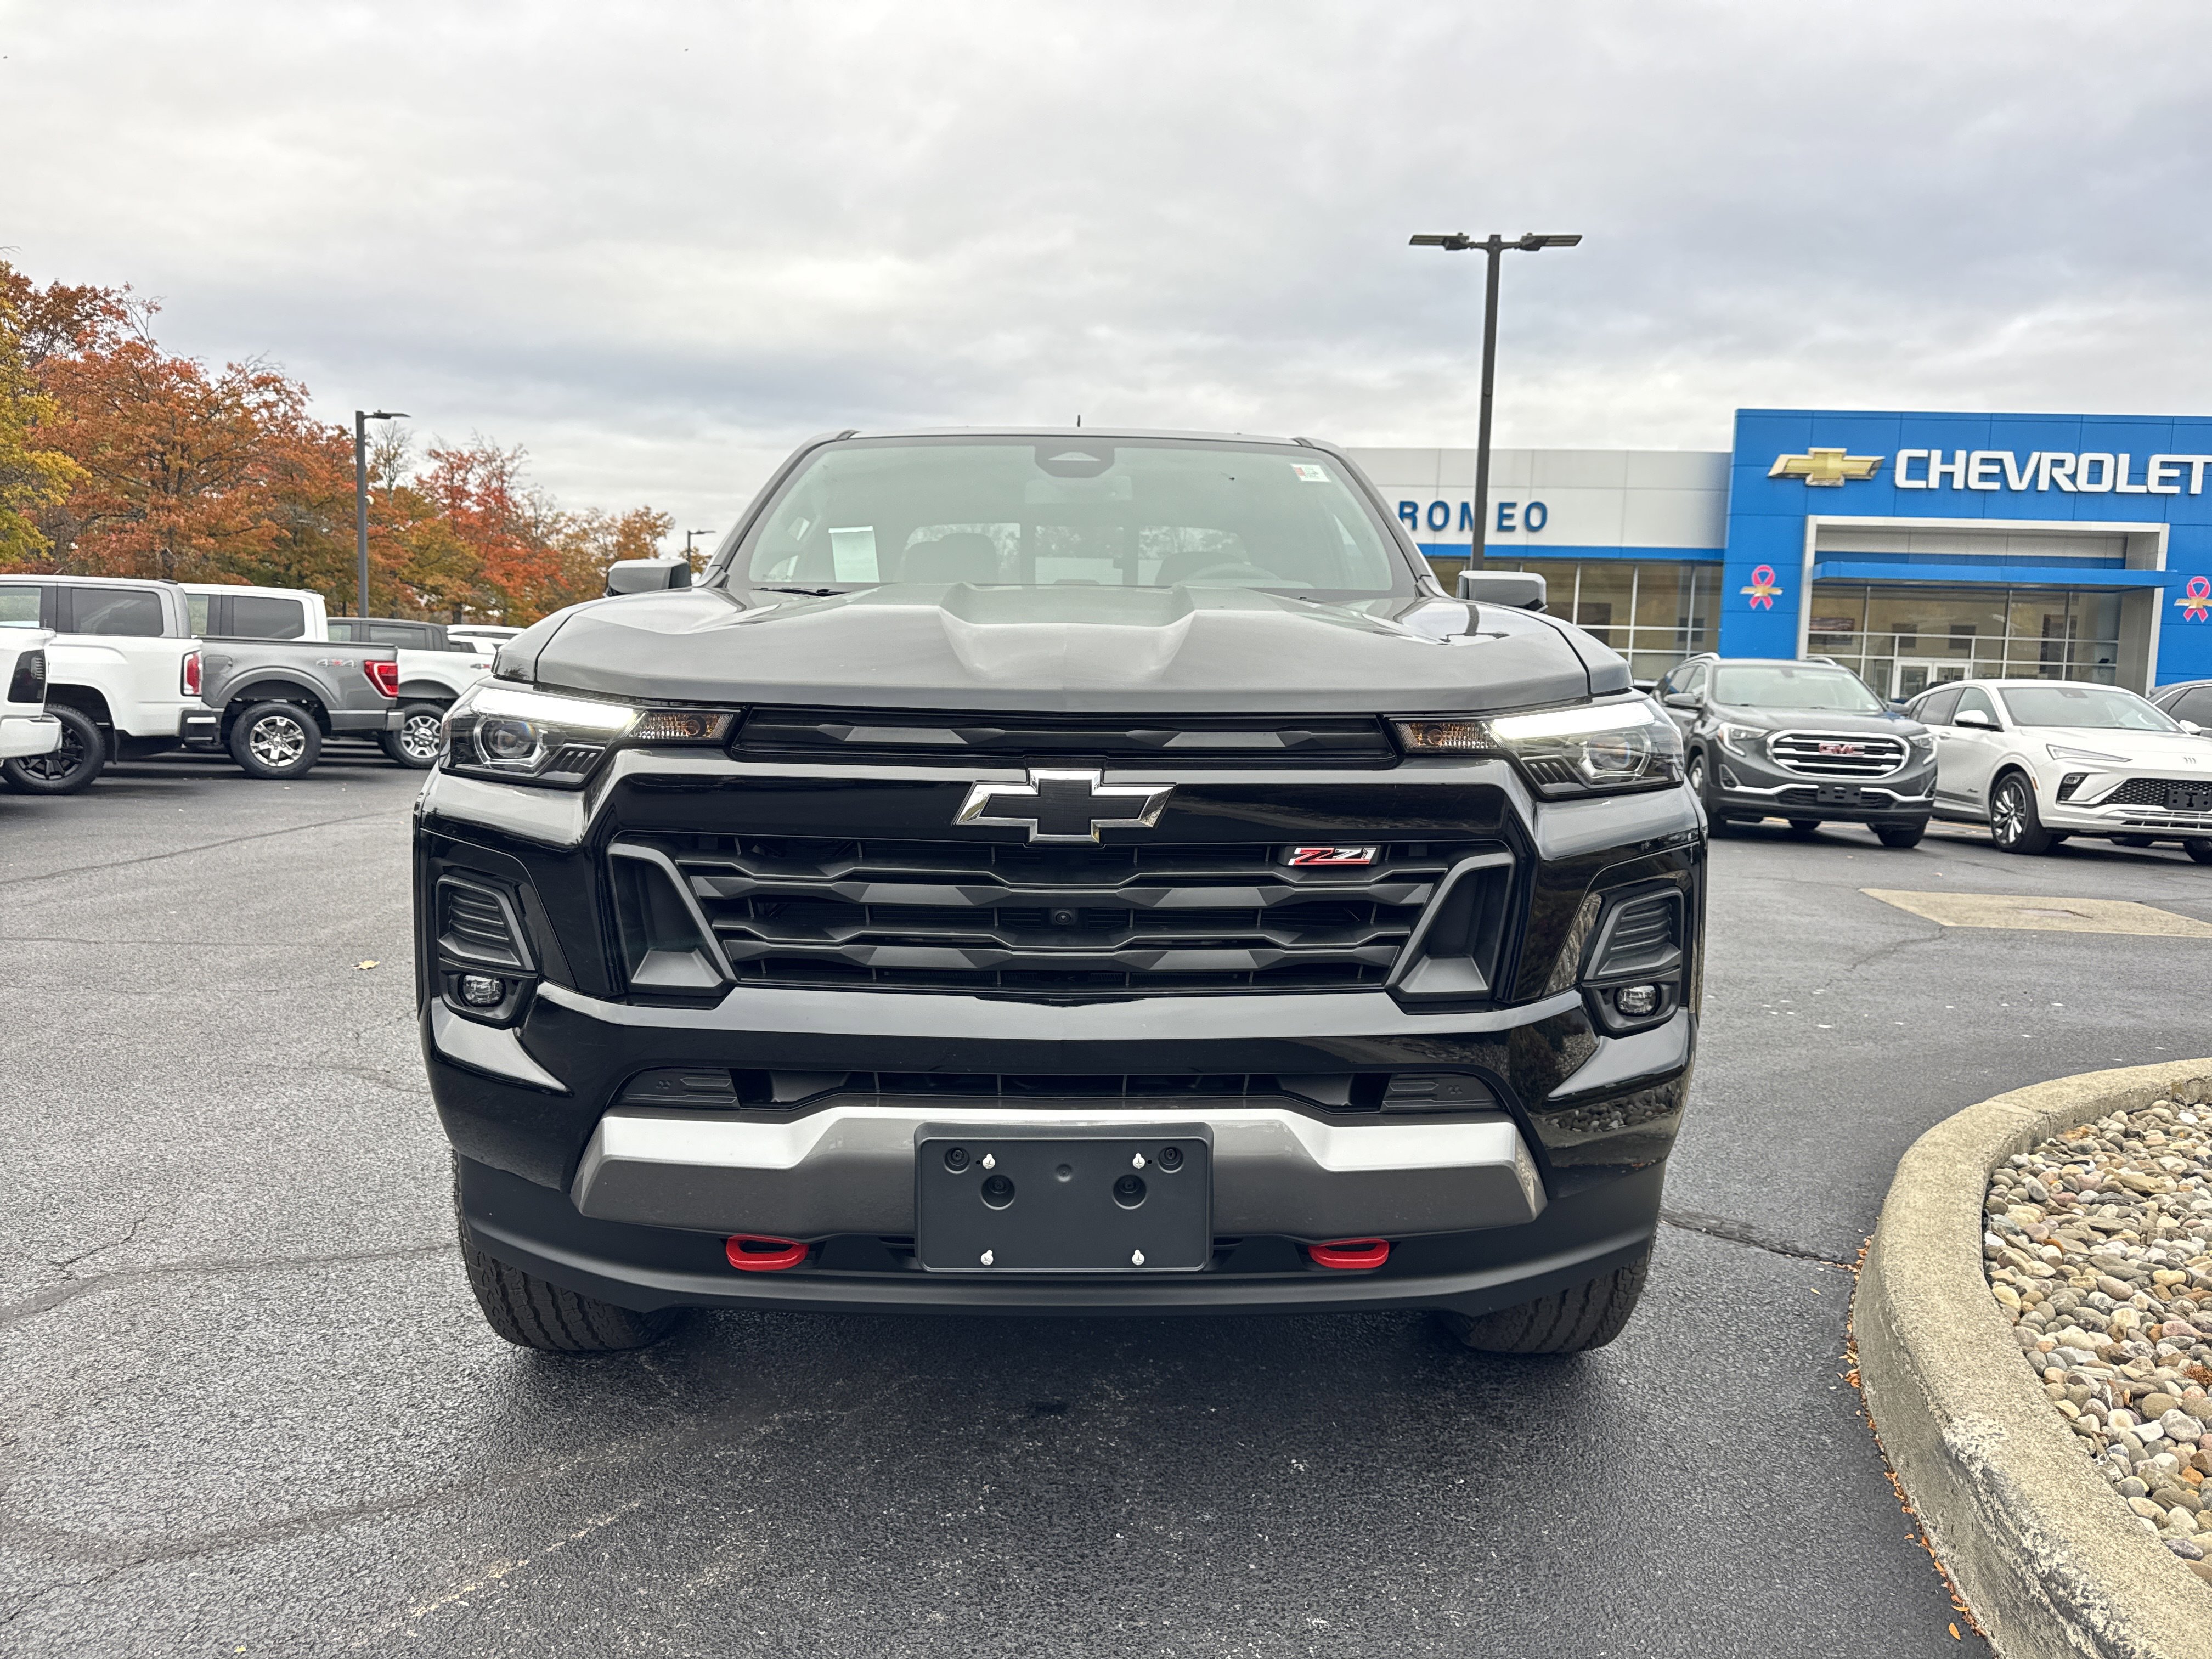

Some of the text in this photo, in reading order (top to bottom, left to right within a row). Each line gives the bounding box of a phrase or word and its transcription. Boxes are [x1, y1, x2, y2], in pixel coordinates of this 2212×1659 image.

[1894, 449, 2212, 494] CHEVROLET
[1818, 742, 1865, 756] GMC
[1288, 847, 1377, 865] Z71
